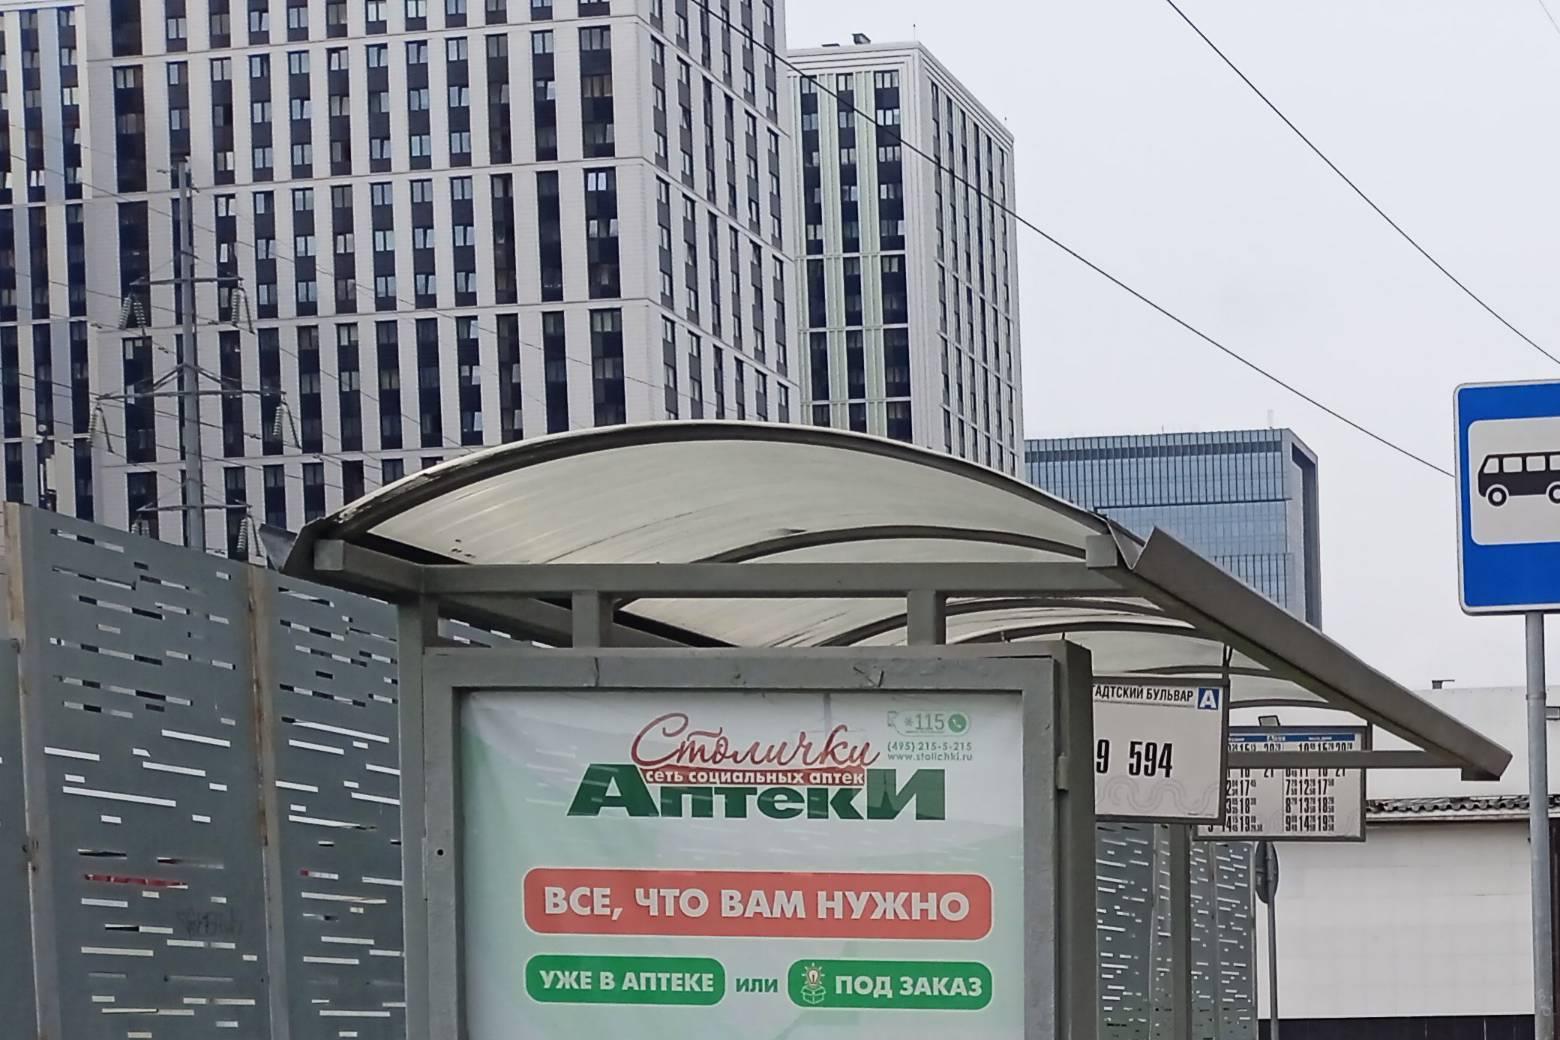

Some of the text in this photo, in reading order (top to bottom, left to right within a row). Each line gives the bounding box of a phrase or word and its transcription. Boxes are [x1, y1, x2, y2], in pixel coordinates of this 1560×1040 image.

[1146, 688, 1194, 702] БУЛЬВАР
[631, 712, 880, 768] Столички
[887, 741, 972, 752] (495) 215-5-215
[887, 752, 973, 761] www.stolichki.ru
[1129, 741, 1173, 778] 594
[646, 771, 864, 785] сеть социальных аптек
[544, 886, 970, 922] ВСЕ, ЧТО ВАМ НУЖНО
[539, 971, 714, 992] УЖЕ В АПТЕКЕ
[835, 975, 982, 998] ПОД ЗАКАЗ
